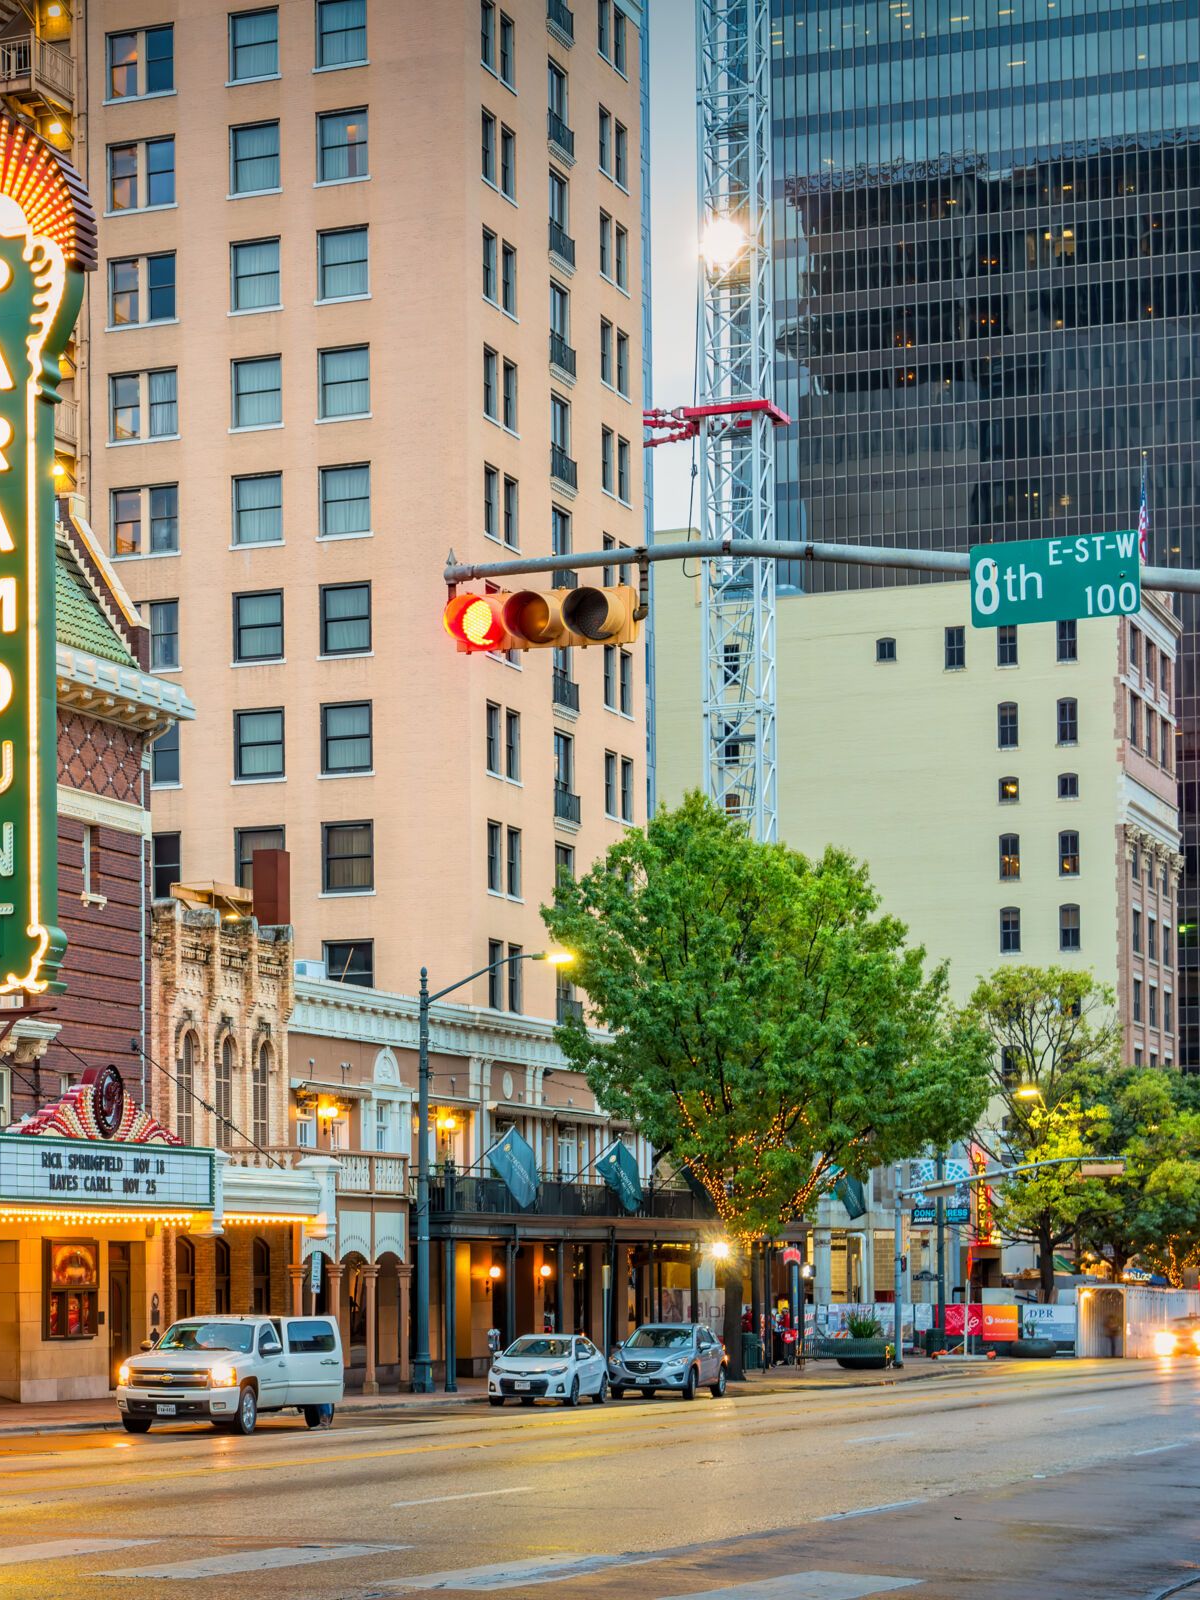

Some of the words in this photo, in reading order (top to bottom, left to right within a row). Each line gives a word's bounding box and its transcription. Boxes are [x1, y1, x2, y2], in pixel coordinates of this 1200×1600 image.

[1048, 533, 1135, 565] E-ST-W
[974, 557, 1044, 615] 8th
[1084, 582, 1138, 615] 100
[41, 1151, 63, 1169] RICK
[68, 1153, 123, 1172] SPRINGFIELD
[133, 1157, 150, 1174] NOV
[156, 1159, 165, 1175] 18
[49, 1174, 78, 1191] HAYES
[84, 1176, 113, 1193] CARLL
[122, 1178, 140, 1194] NOV
[145, 1179, 157, 1195] 25
[1028, 1309, 1055, 1318] DPR
